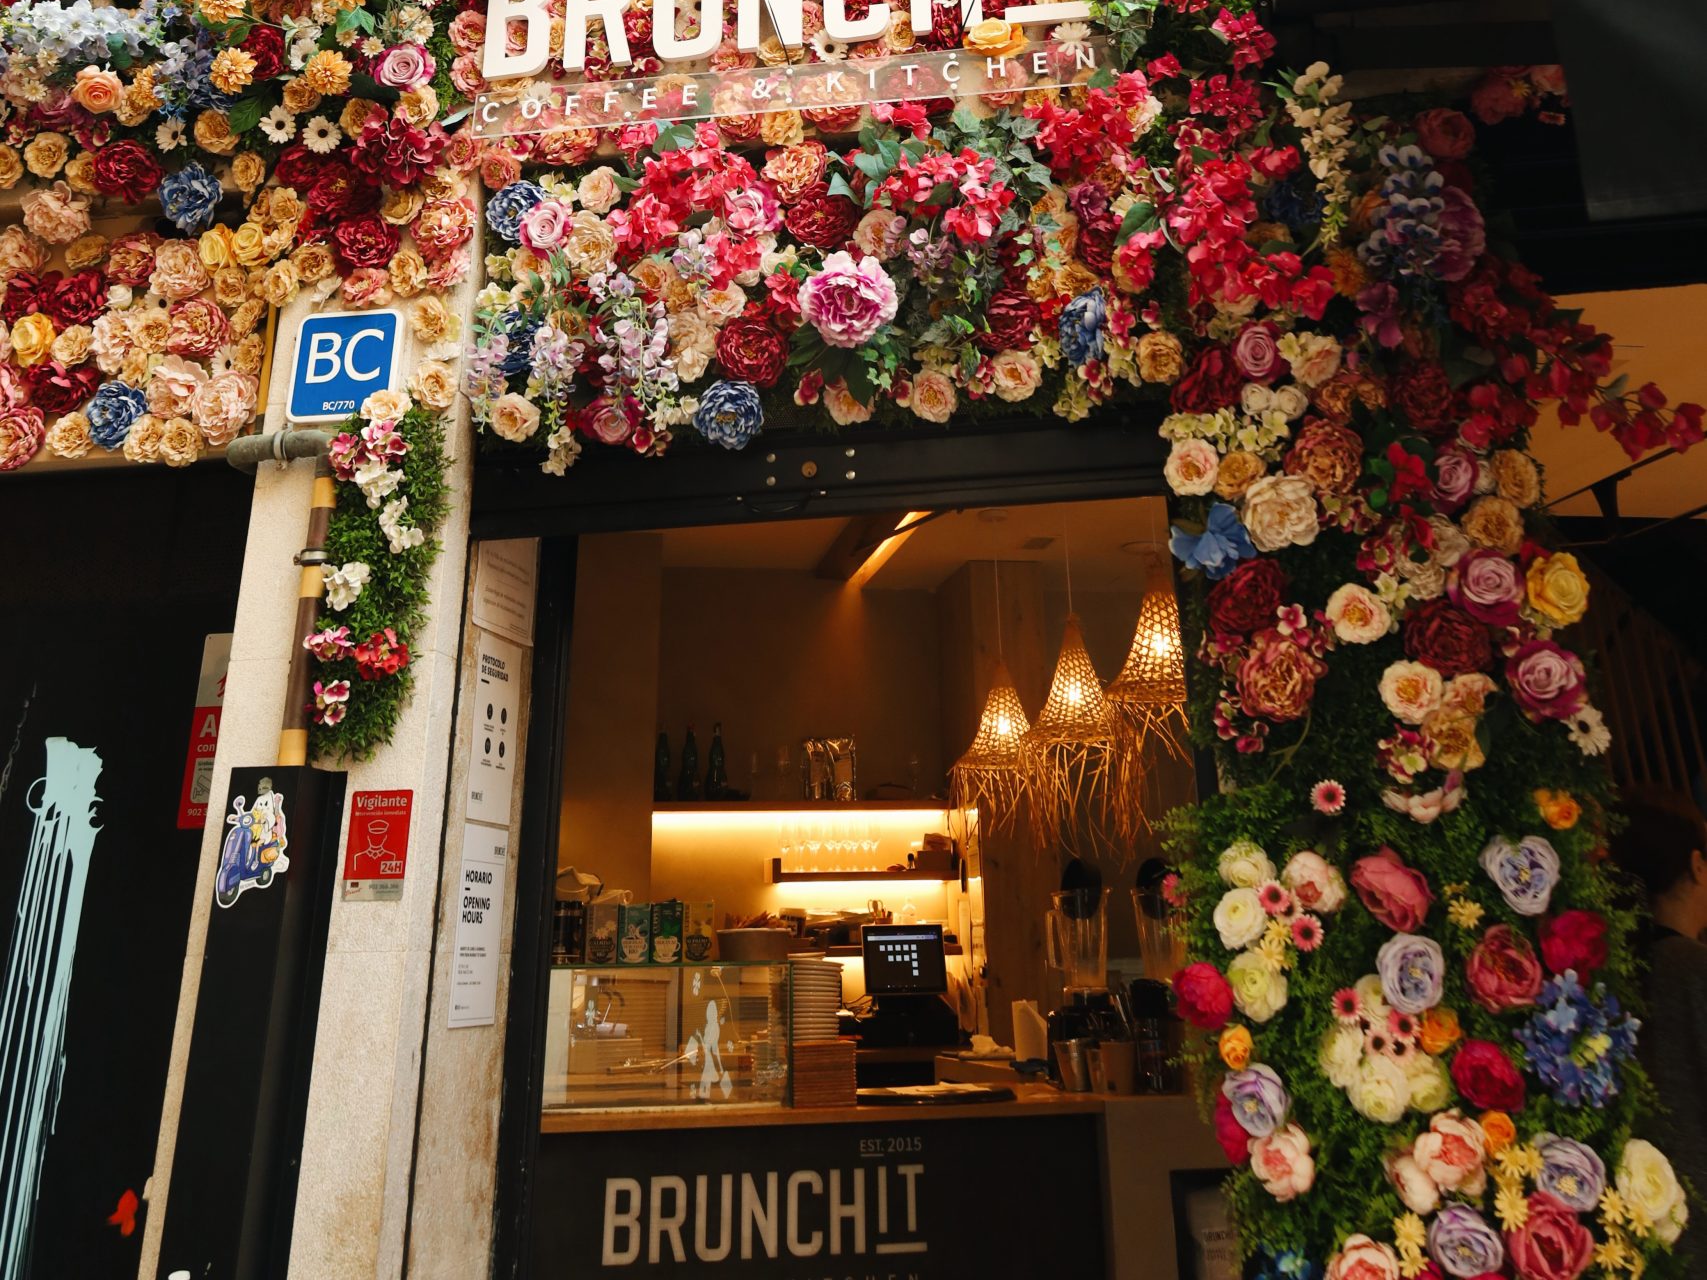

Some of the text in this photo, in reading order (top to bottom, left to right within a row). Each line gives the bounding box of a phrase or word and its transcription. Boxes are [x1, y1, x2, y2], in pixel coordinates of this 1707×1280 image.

[482, 48, 1097, 123] COFFEE & KITCHEN
[305, 328, 385, 384] BC
[322, 400, 355, 411] BC/770
[482, 654, 506, 670] PROTOCOLO
[481, 665, 509, 682] DE SEGURIDAD
[356, 795, 408, 811] Vigilante
[381, 862, 403, 874] 24H
[465, 870, 493, 885] HORARIO
[463, 895, 491, 910] OPENING
[462, 911, 483, 924] HOURS
[860, 1136, 922, 1157] EST. 2015
[602, 1163, 928, 1267] BRUNCHIT
